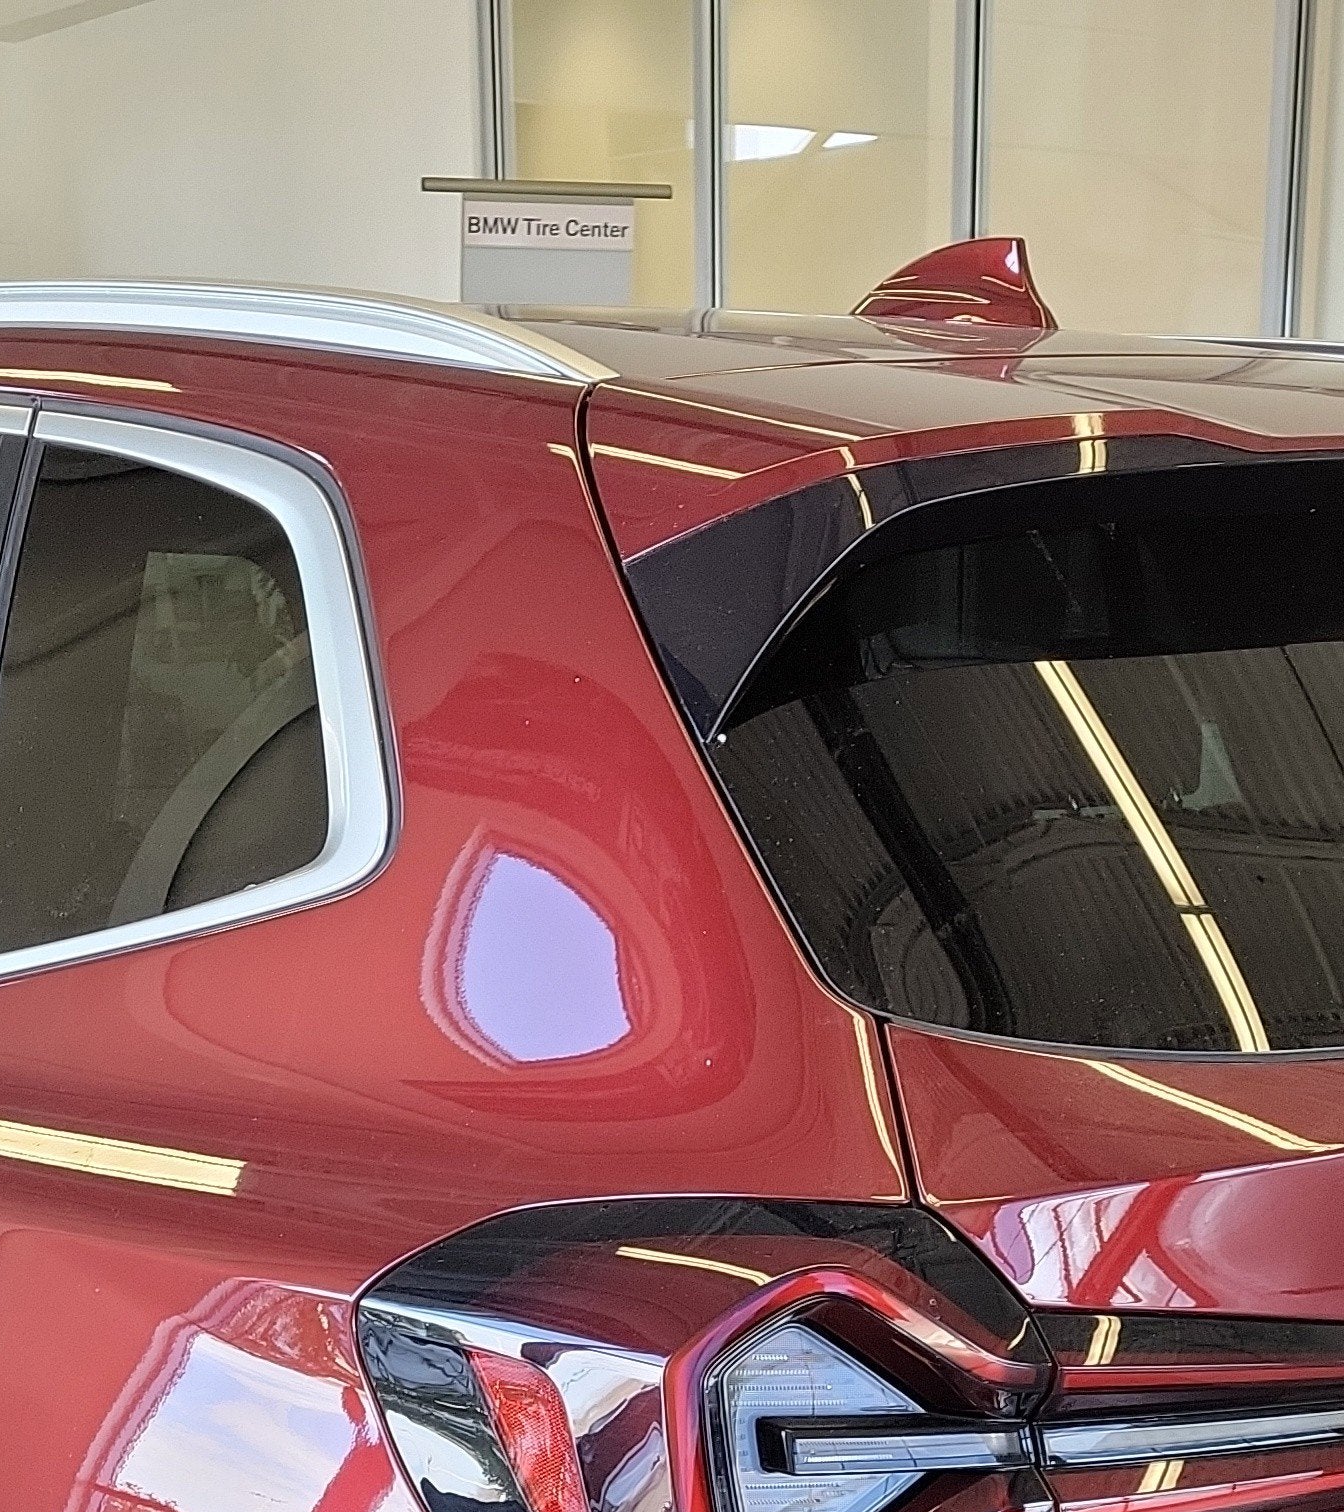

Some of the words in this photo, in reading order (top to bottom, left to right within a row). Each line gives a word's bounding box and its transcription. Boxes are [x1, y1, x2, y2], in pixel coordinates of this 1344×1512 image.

[467, 216, 519, 236] BMW
[522, 217, 560, 237] Tire
[565, 219, 630, 239] Center
